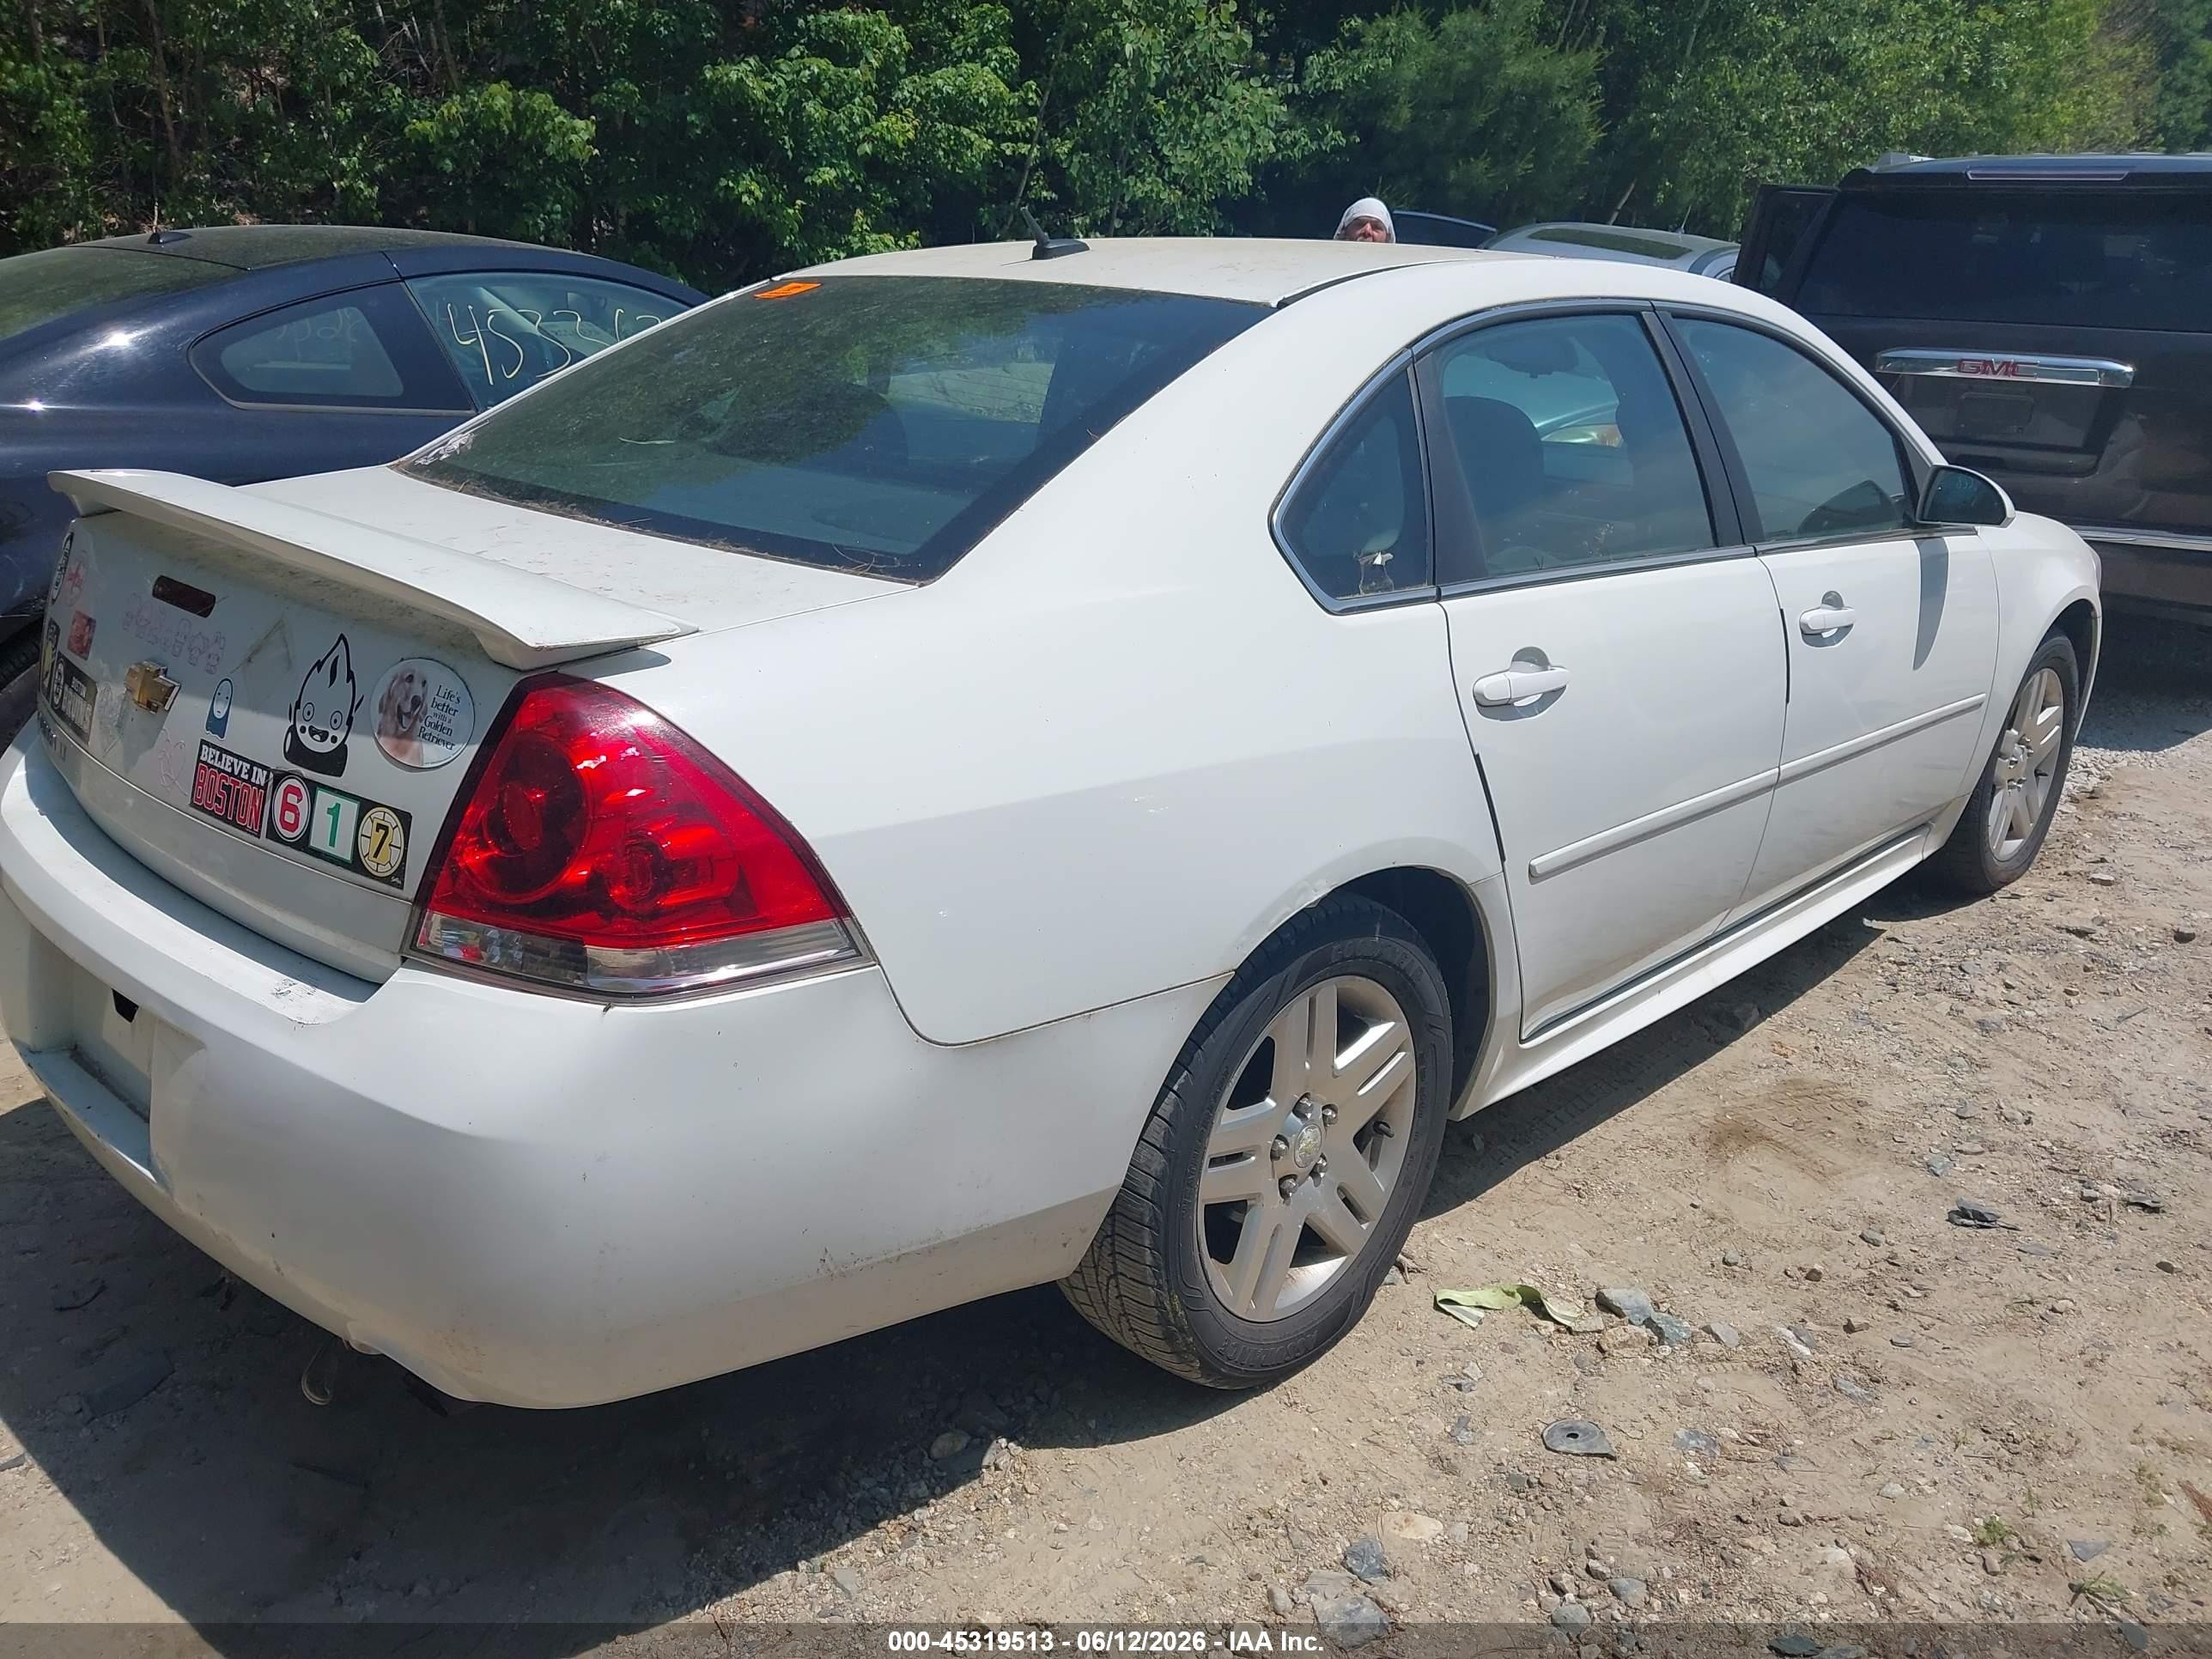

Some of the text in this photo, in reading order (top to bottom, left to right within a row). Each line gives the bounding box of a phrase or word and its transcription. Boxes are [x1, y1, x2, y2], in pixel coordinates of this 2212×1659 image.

[1957, 357, 2040, 379] GMC
[436, 684, 461, 704] Life's
[431, 697, 459, 716] better
[433, 711, 447, 722] with
[424, 715, 453, 737] Golden
[417, 726, 455, 750] Retriever
[200, 744, 267, 786] BELIEVE IN
[193, 763, 264, 832] BOSTON
[279, 783, 389, 859] 6 1 7
